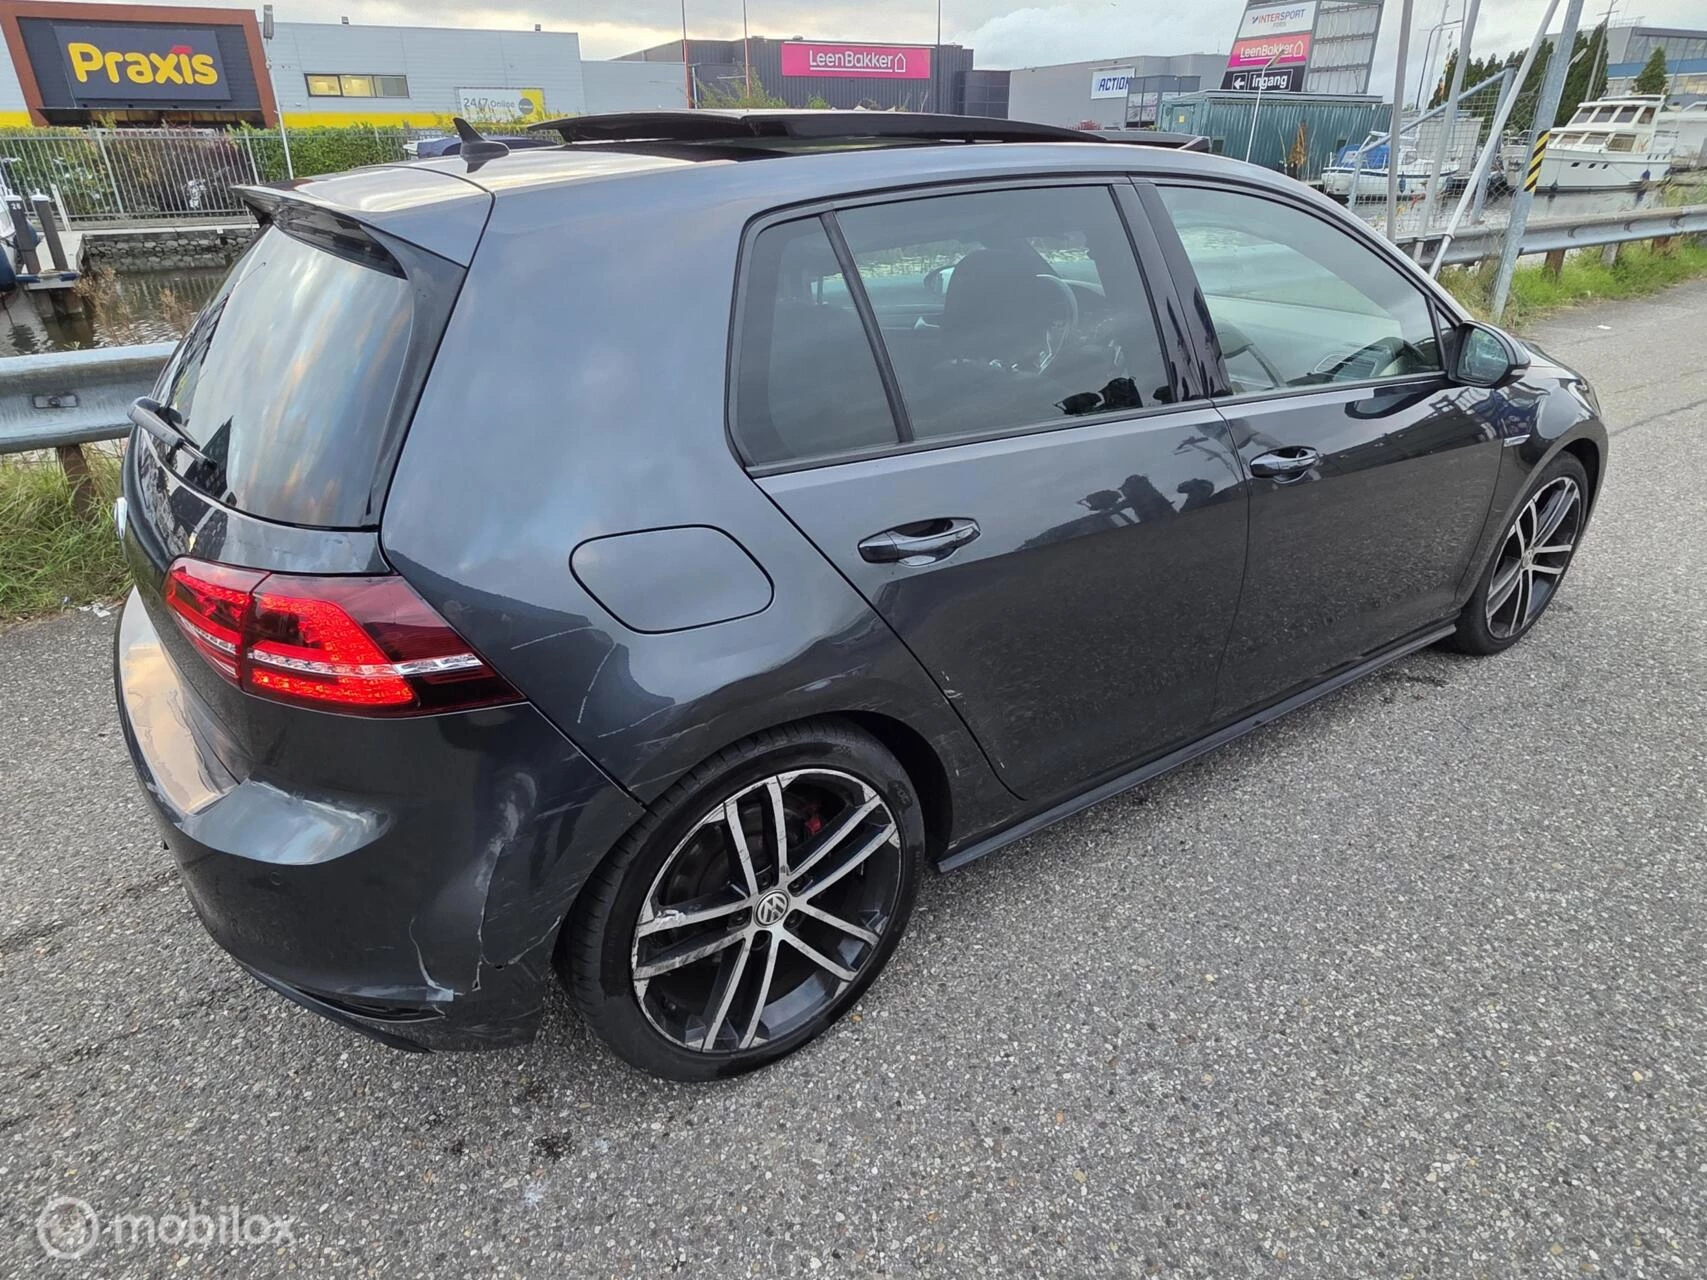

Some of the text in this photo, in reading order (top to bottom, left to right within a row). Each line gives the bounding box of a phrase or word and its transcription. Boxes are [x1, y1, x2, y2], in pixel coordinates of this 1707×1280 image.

[1258, 8, 1306, 24] INTERSPORT
[1240, 42, 1295, 58] LeenBakker
[67, 42, 218, 85] Praxis
[809, 49, 894, 68] LeenBakker
[1251, 74, 1288, 90] ingang
